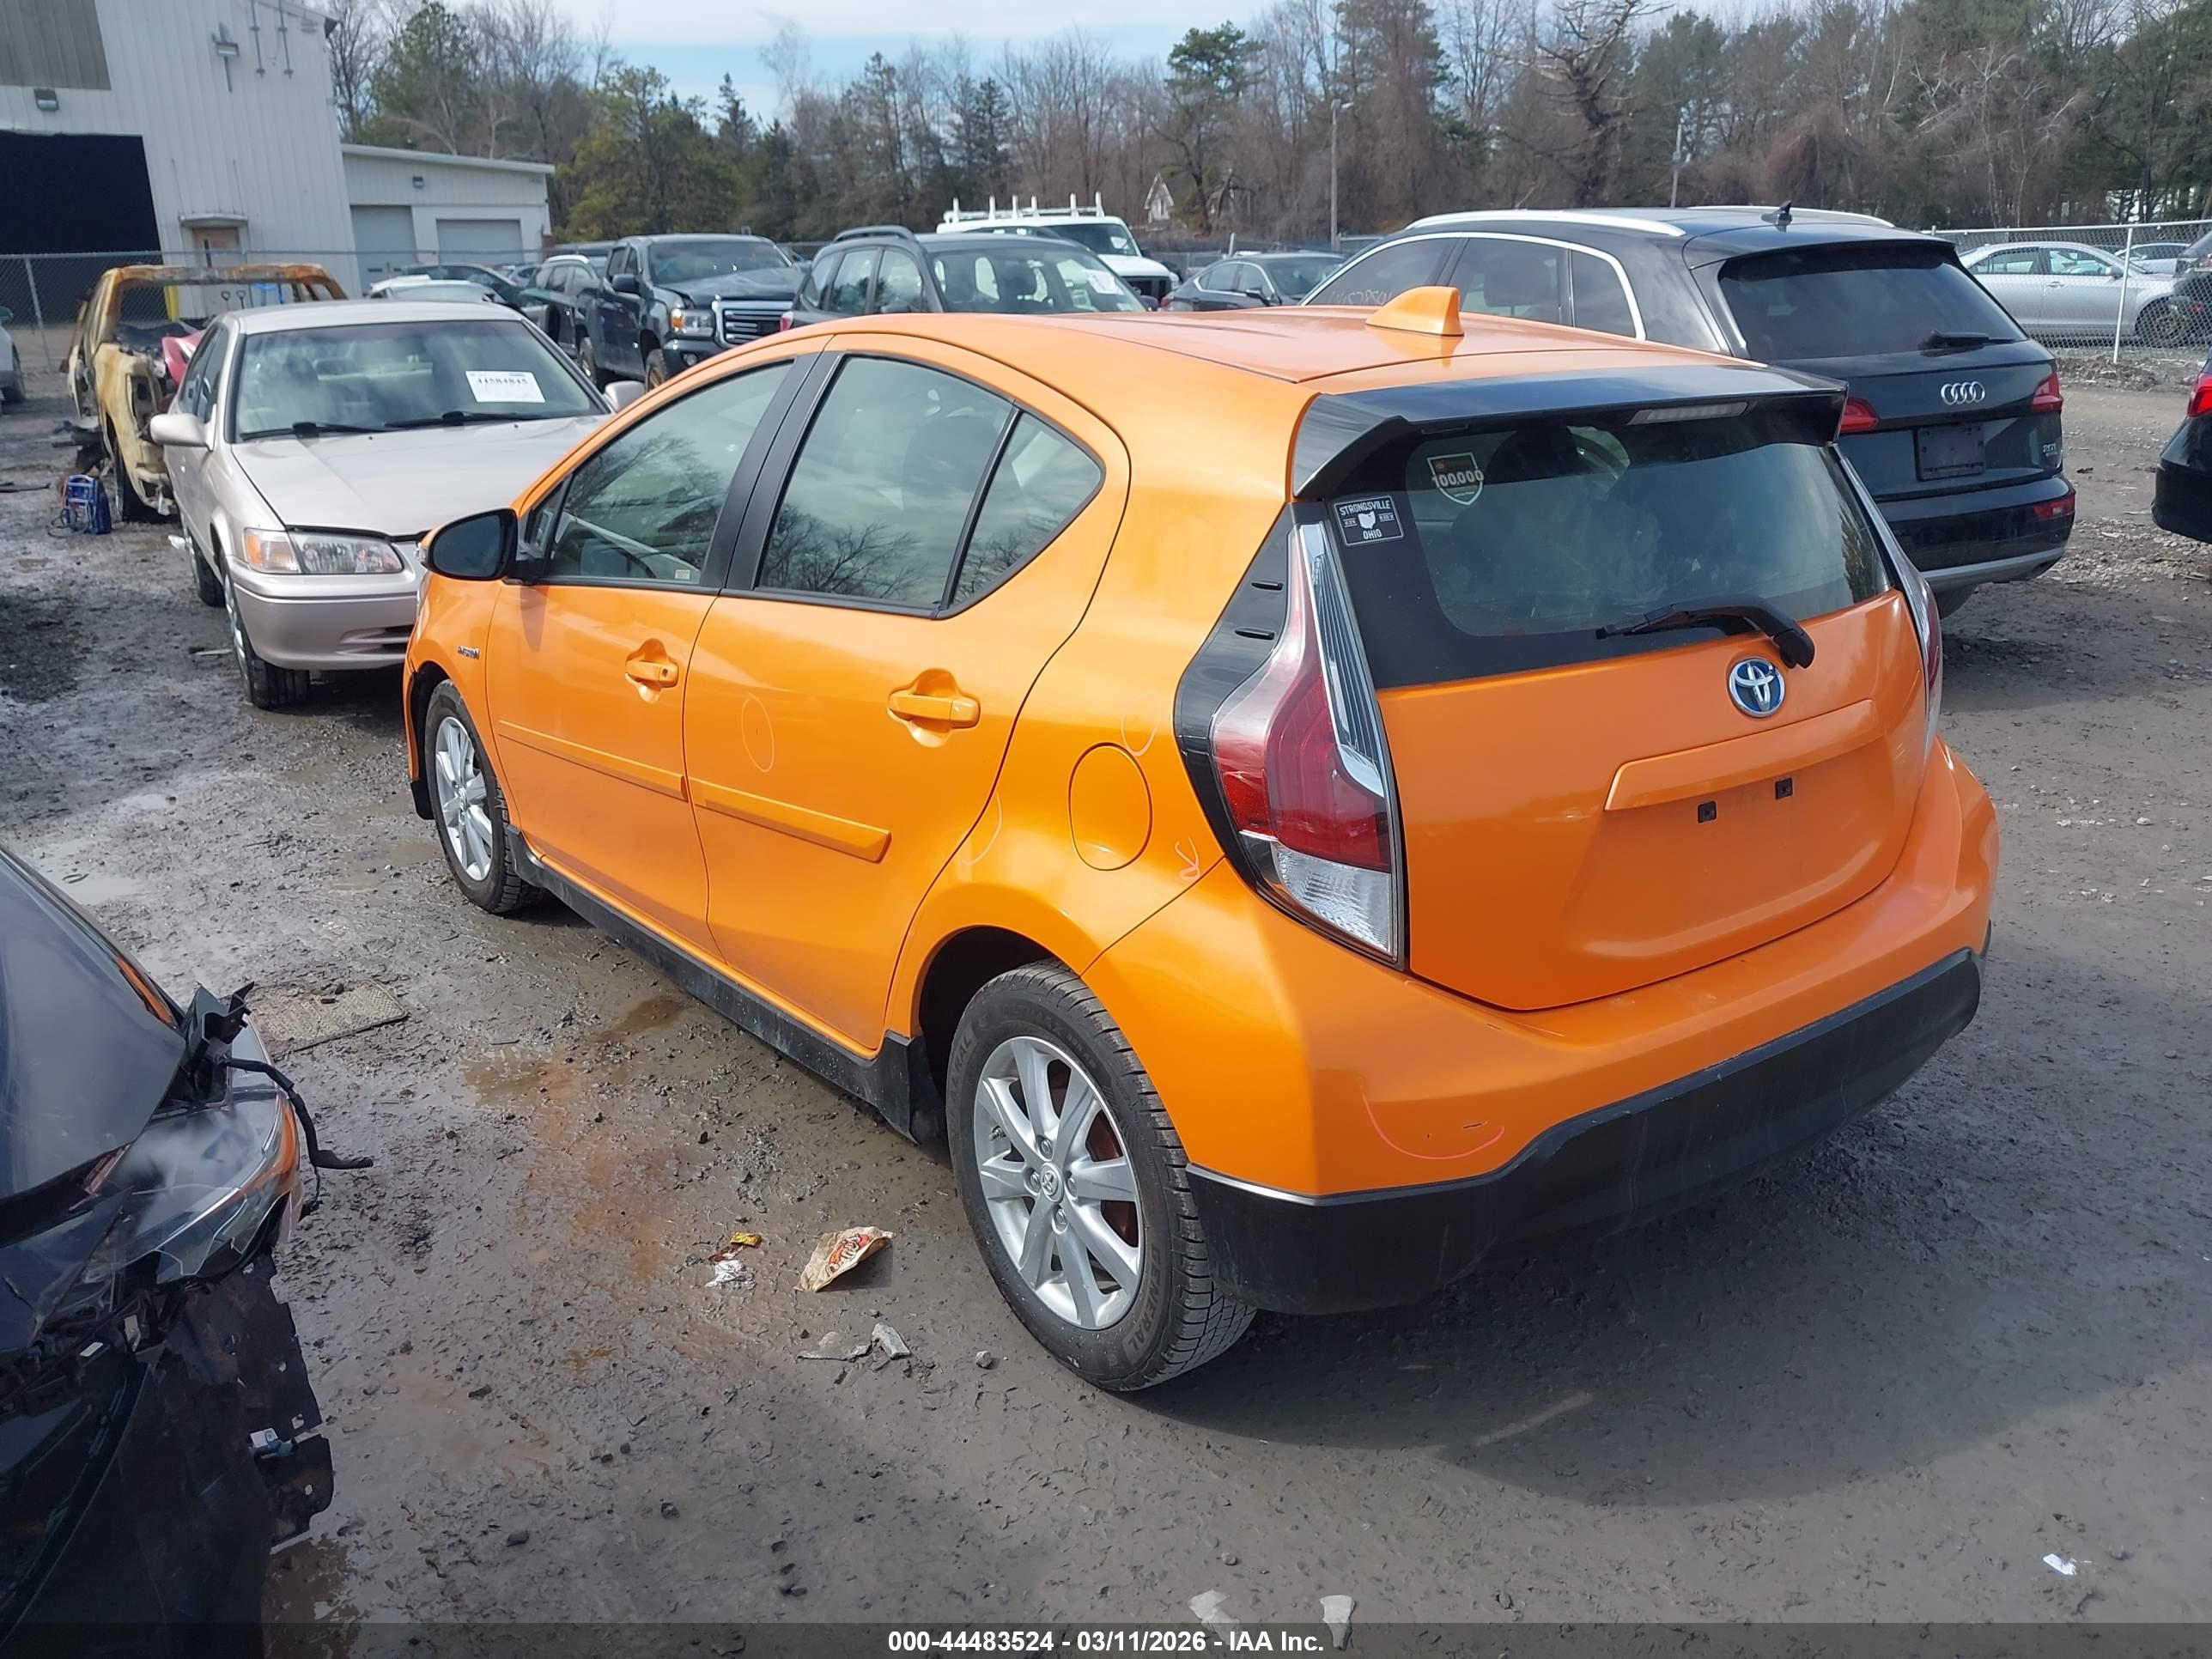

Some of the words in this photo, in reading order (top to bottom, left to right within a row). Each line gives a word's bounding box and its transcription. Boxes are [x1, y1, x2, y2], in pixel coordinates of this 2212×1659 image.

[1431, 470, 1484, 488] 100,000
[1340, 500, 1391, 516] STRONGSVILLE
[1363, 528, 1382, 540] OHIO
[1127, 1246, 1160, 1352] GENERAL
